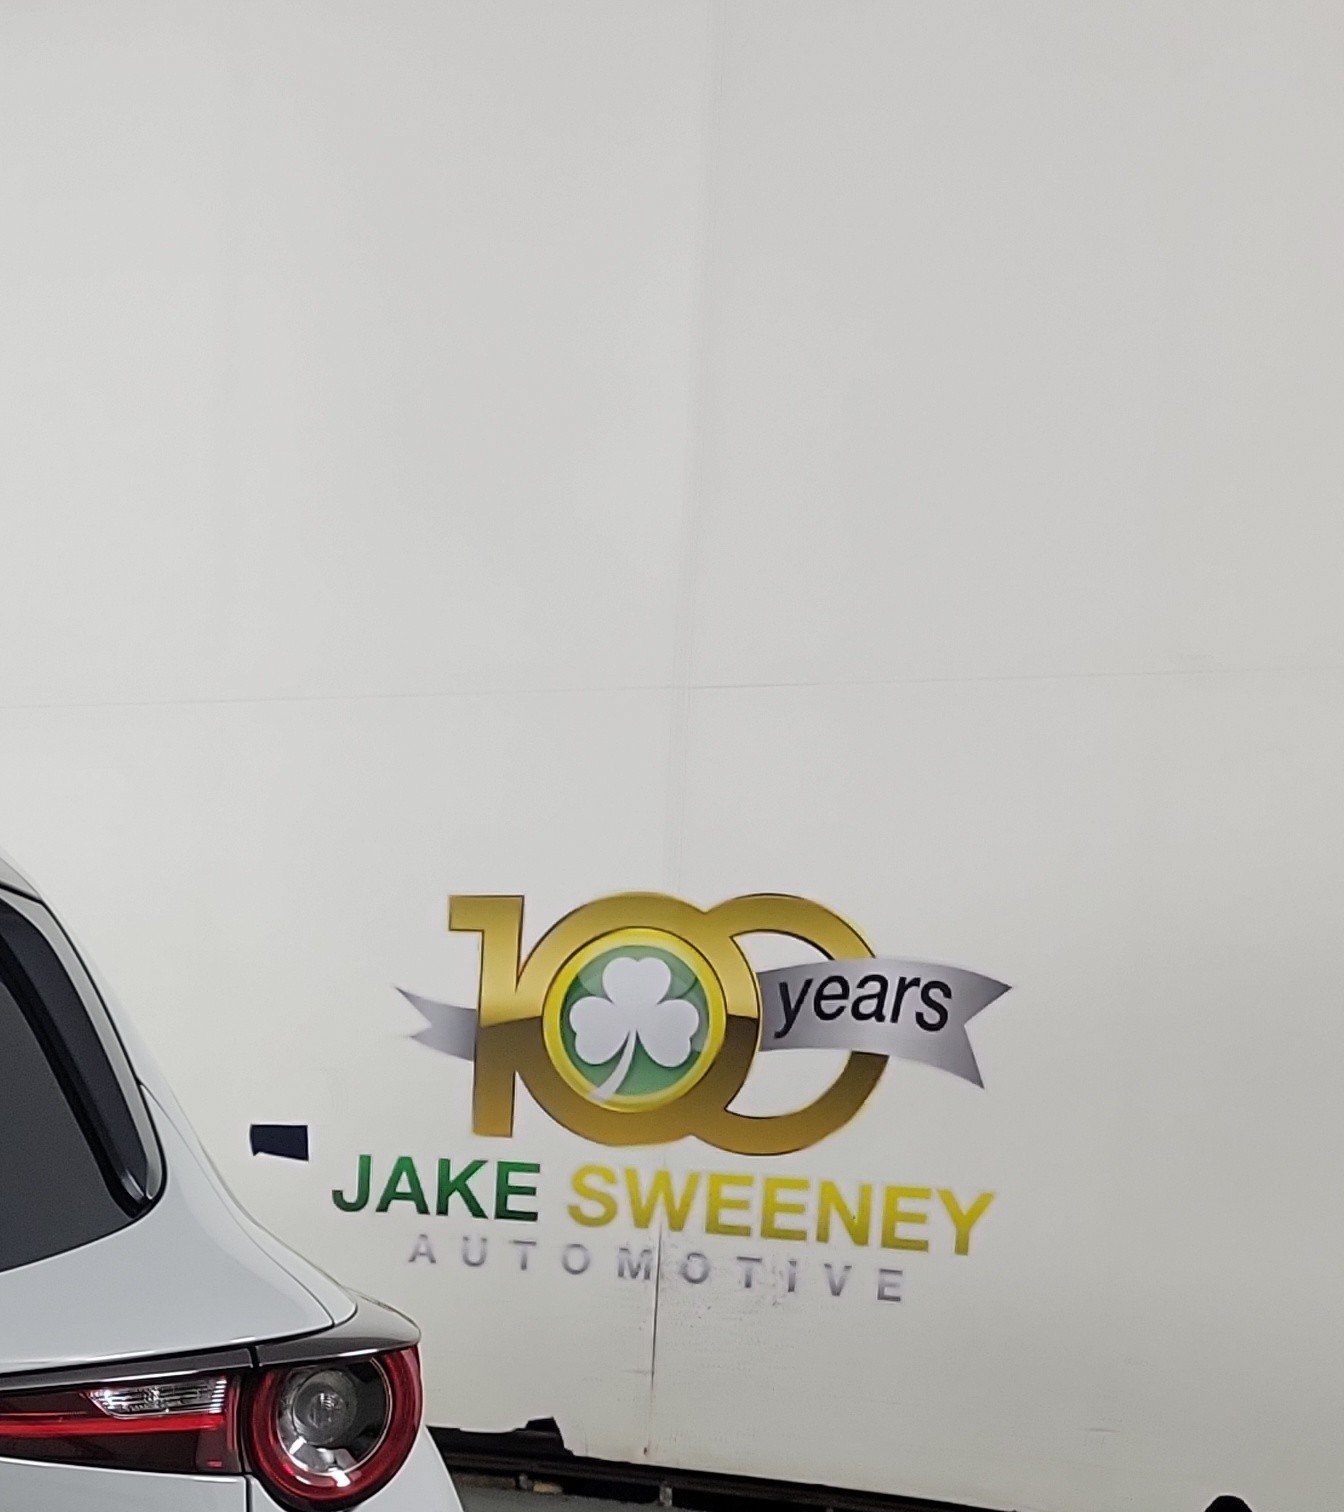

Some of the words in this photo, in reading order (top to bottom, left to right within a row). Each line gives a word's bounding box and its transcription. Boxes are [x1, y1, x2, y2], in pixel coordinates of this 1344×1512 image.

[774, 972, 955, 1039] years
[332, 1154, 542, 1223] JAKE
[567, 1164, 996, 1258] SWEENEY
[407, 1232, 906, 1304] AUTOMOTIVE
